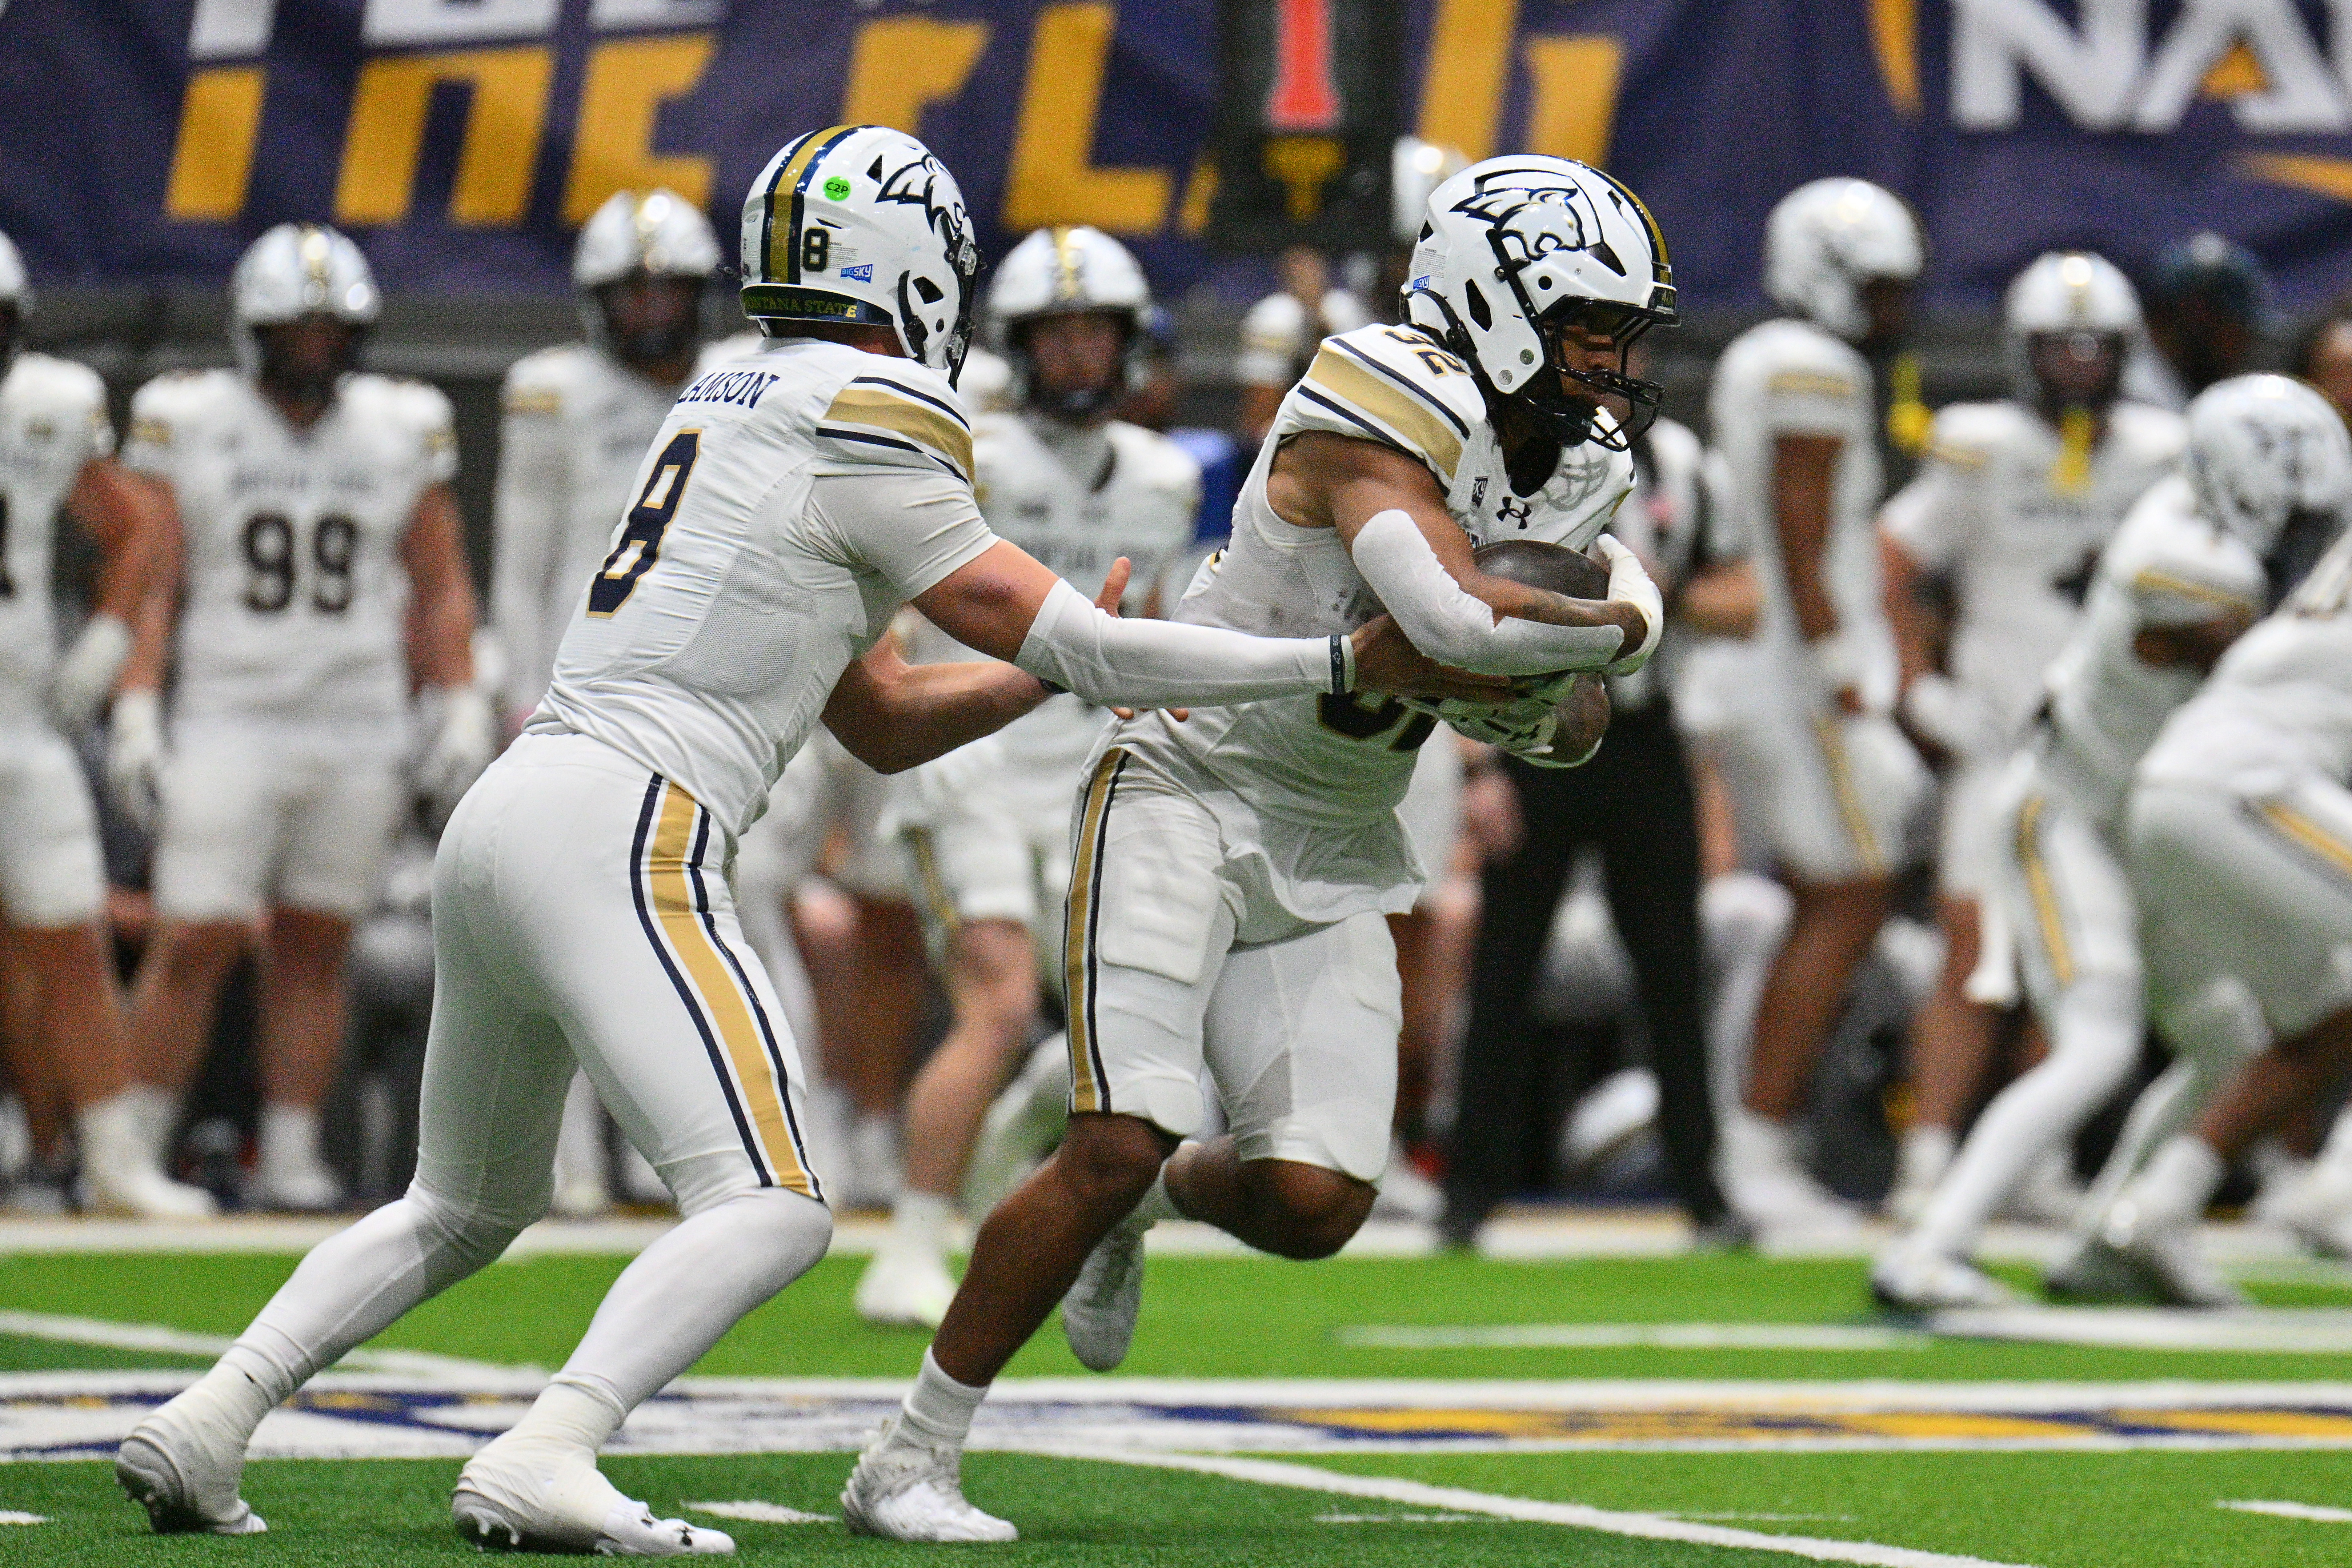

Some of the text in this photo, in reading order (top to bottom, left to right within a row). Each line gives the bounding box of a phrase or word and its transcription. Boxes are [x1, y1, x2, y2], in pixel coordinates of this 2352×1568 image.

[826, 182, 848, 194] C2P
[802, 226, 830, 273] 8
[804, 299, 857, 318] STATE
[586, 428, 702, 619] 8
[243, 509, 360, 614] 99
